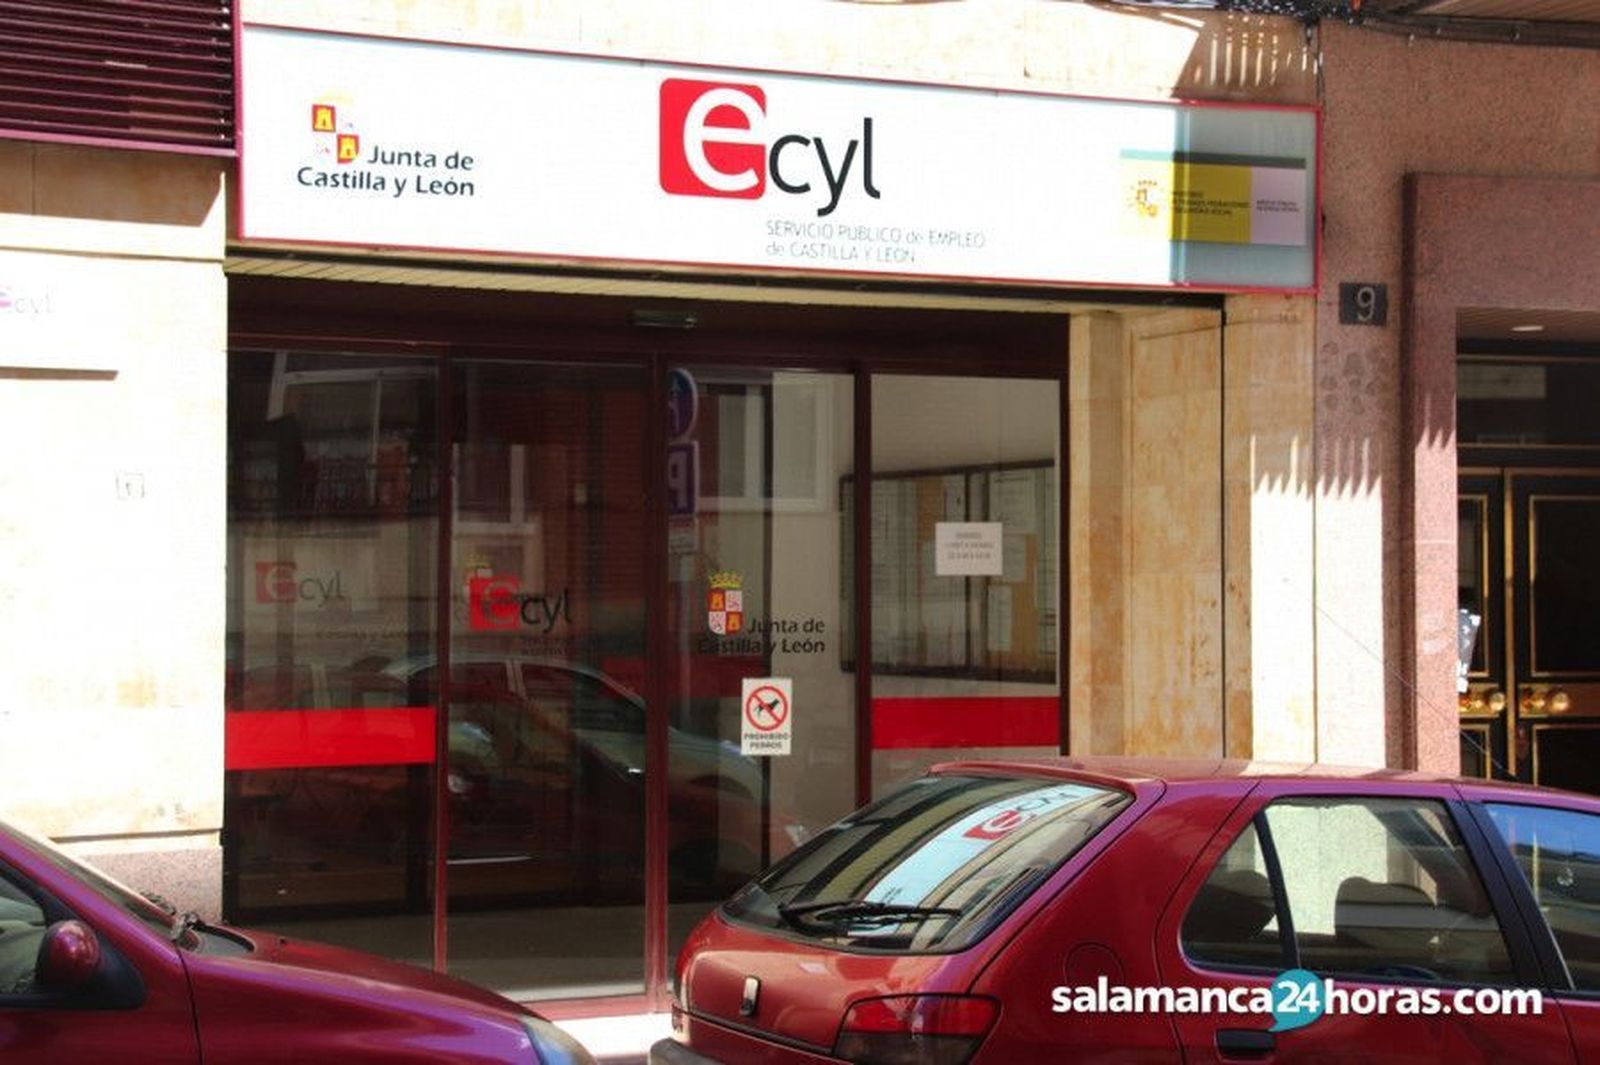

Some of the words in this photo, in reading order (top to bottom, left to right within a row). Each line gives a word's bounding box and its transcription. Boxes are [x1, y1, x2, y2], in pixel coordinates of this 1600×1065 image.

[367, 144, 437, 168] Junta
[444, 150, 475, 171] de
[297, 166, 386, 191] Castilla
[393, 176, 407, 198] y
[415, 174, 475, 196] León
[766, 219, 834, 239] SERVICIO
[905, 226, 925, 245] de
[928, 229, 987, 249] EMPLEO
[766, 241, 785, 257] de
[789, 241, 859, 261] CASTILLA
[863, 245, 874, 261] Y
[1355, 286, 1376, 322] 9
[747, 618, 798, 634] Junta
[803, 618, 825, 634] de
[781, 637, 826, 654] León
